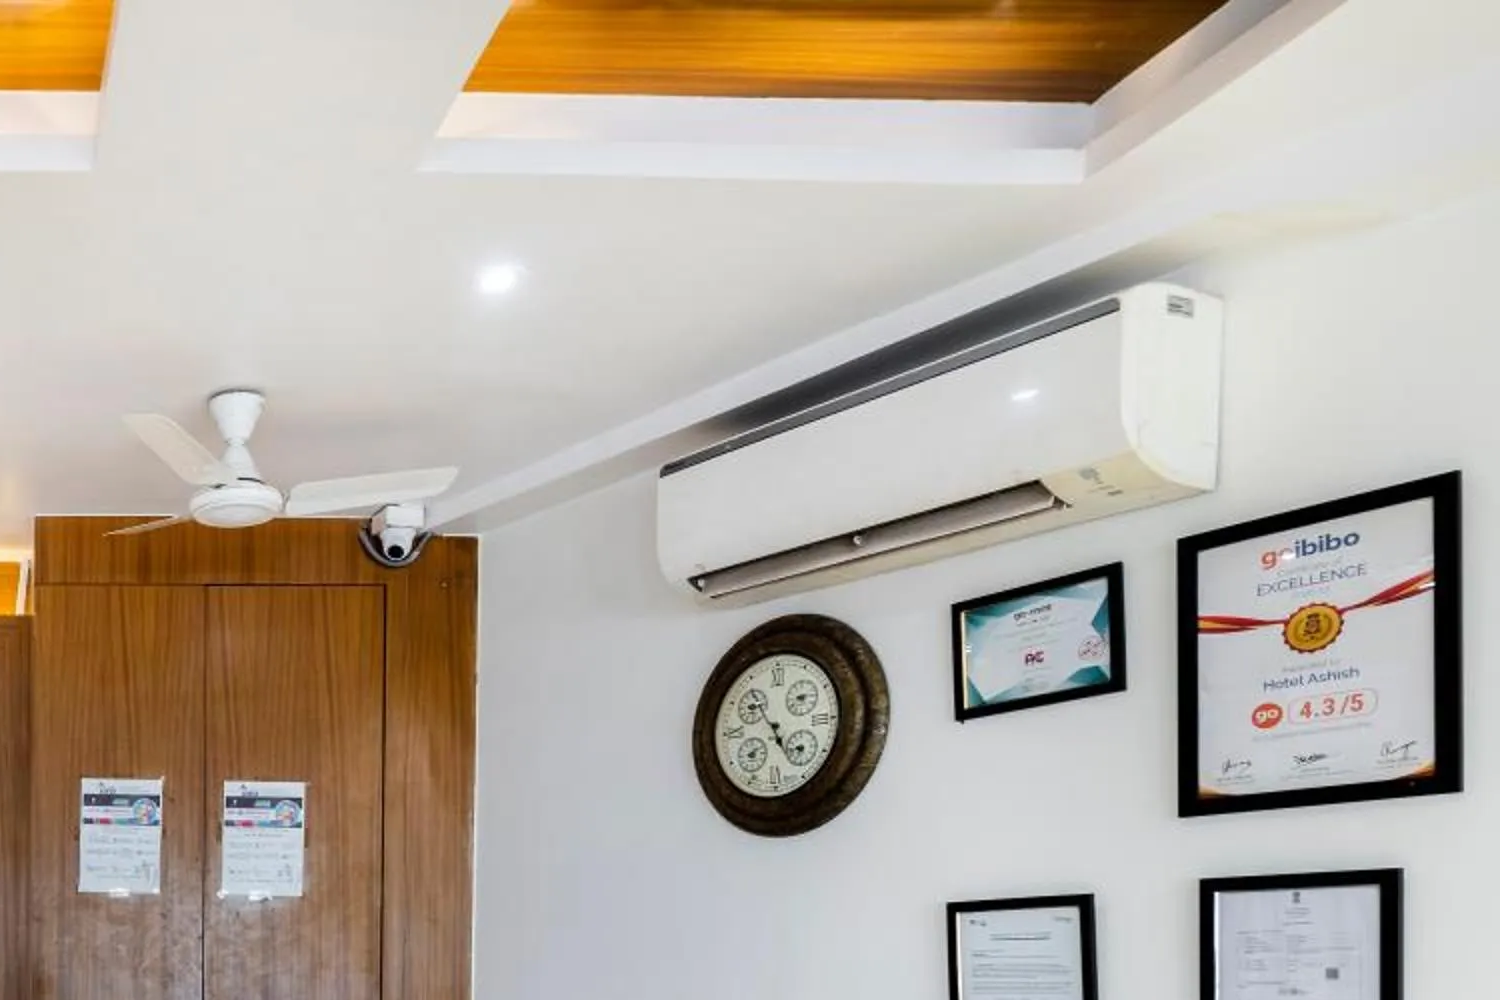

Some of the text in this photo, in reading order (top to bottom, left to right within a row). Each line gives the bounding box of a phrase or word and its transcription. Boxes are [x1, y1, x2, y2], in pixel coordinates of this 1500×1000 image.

[1256, 562, 1367, 597] EXCELLENCE
[1263, 675, 1305, 692] Hotel
[1307, 665, 1361, 684] Ashish
[1255, 709, 1279, 725] go
